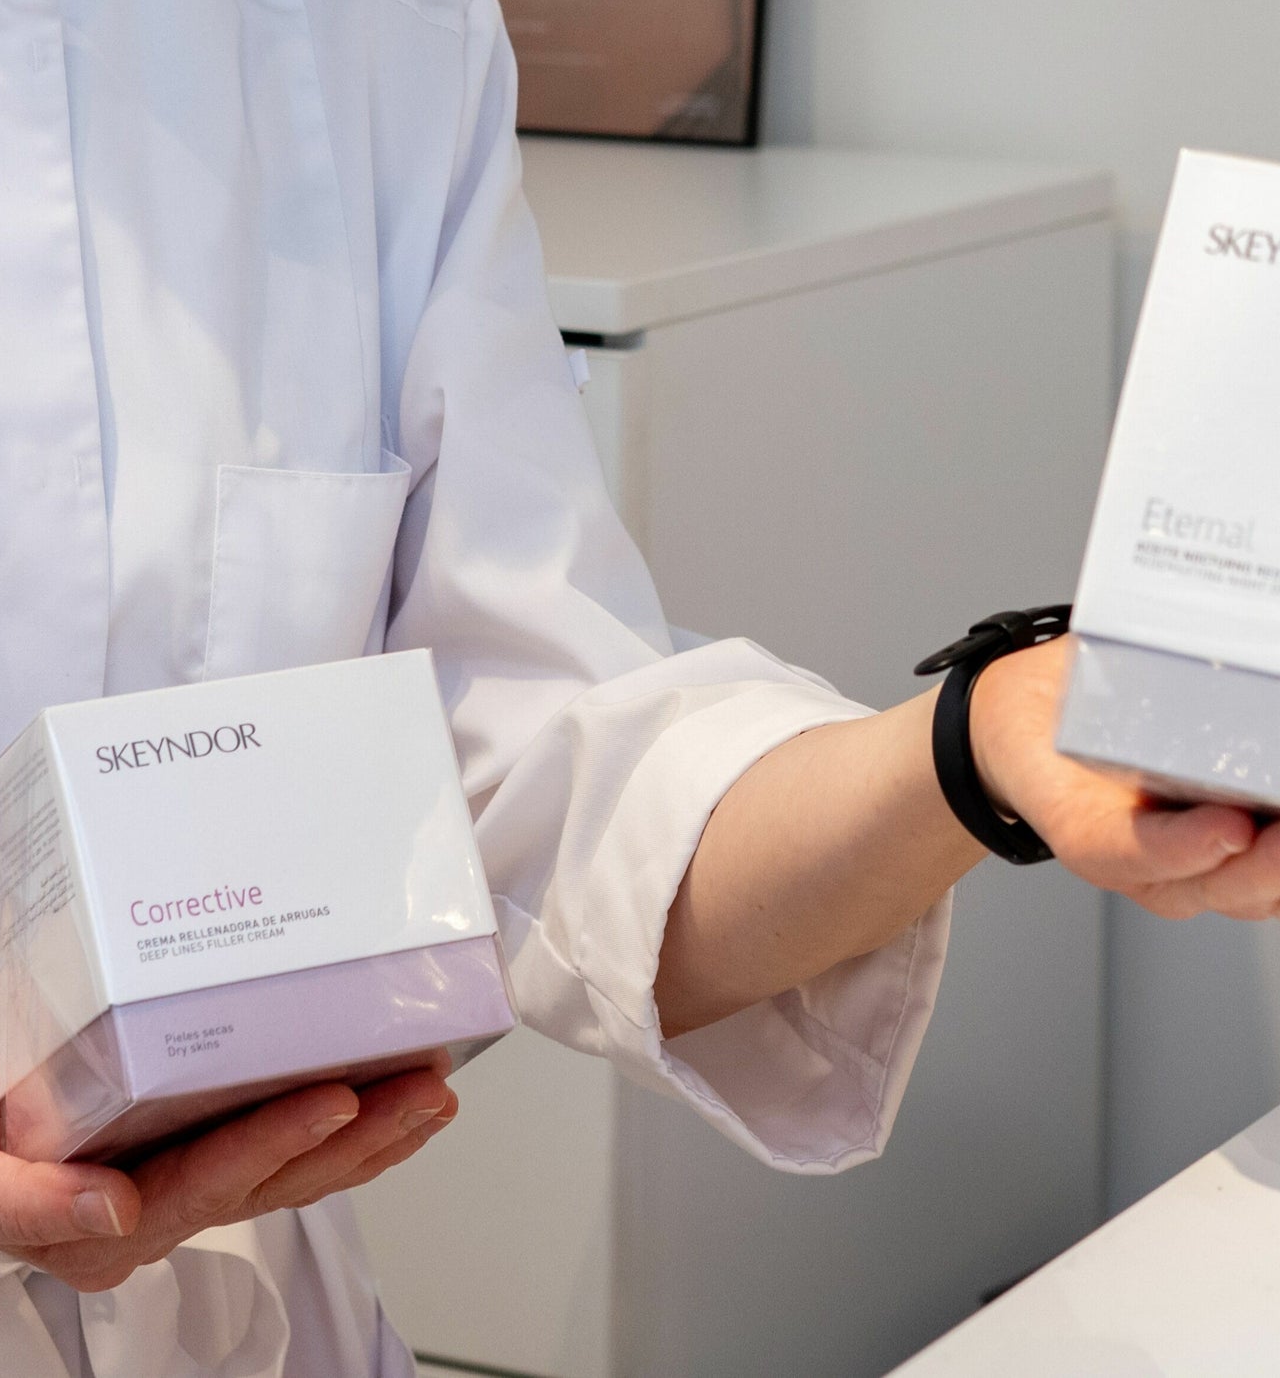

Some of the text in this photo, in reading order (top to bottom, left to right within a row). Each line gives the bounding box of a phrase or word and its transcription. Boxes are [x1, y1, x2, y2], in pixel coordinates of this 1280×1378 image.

[1140, 495, 1256, 552] Eternal
[96, 723, 262, 773] SKEYNDOR
[130, 885, 263, 927] Corrective
[136, 905, 330, 951] CREMA RELLENADORA DE ARRUGAS
[139, 927, 286, 963] DEEP LINES FILLER CREAM
[165, 1024, 234, 1045] Pieles secas
[167, 1039, 220, 1058] Dry skins
